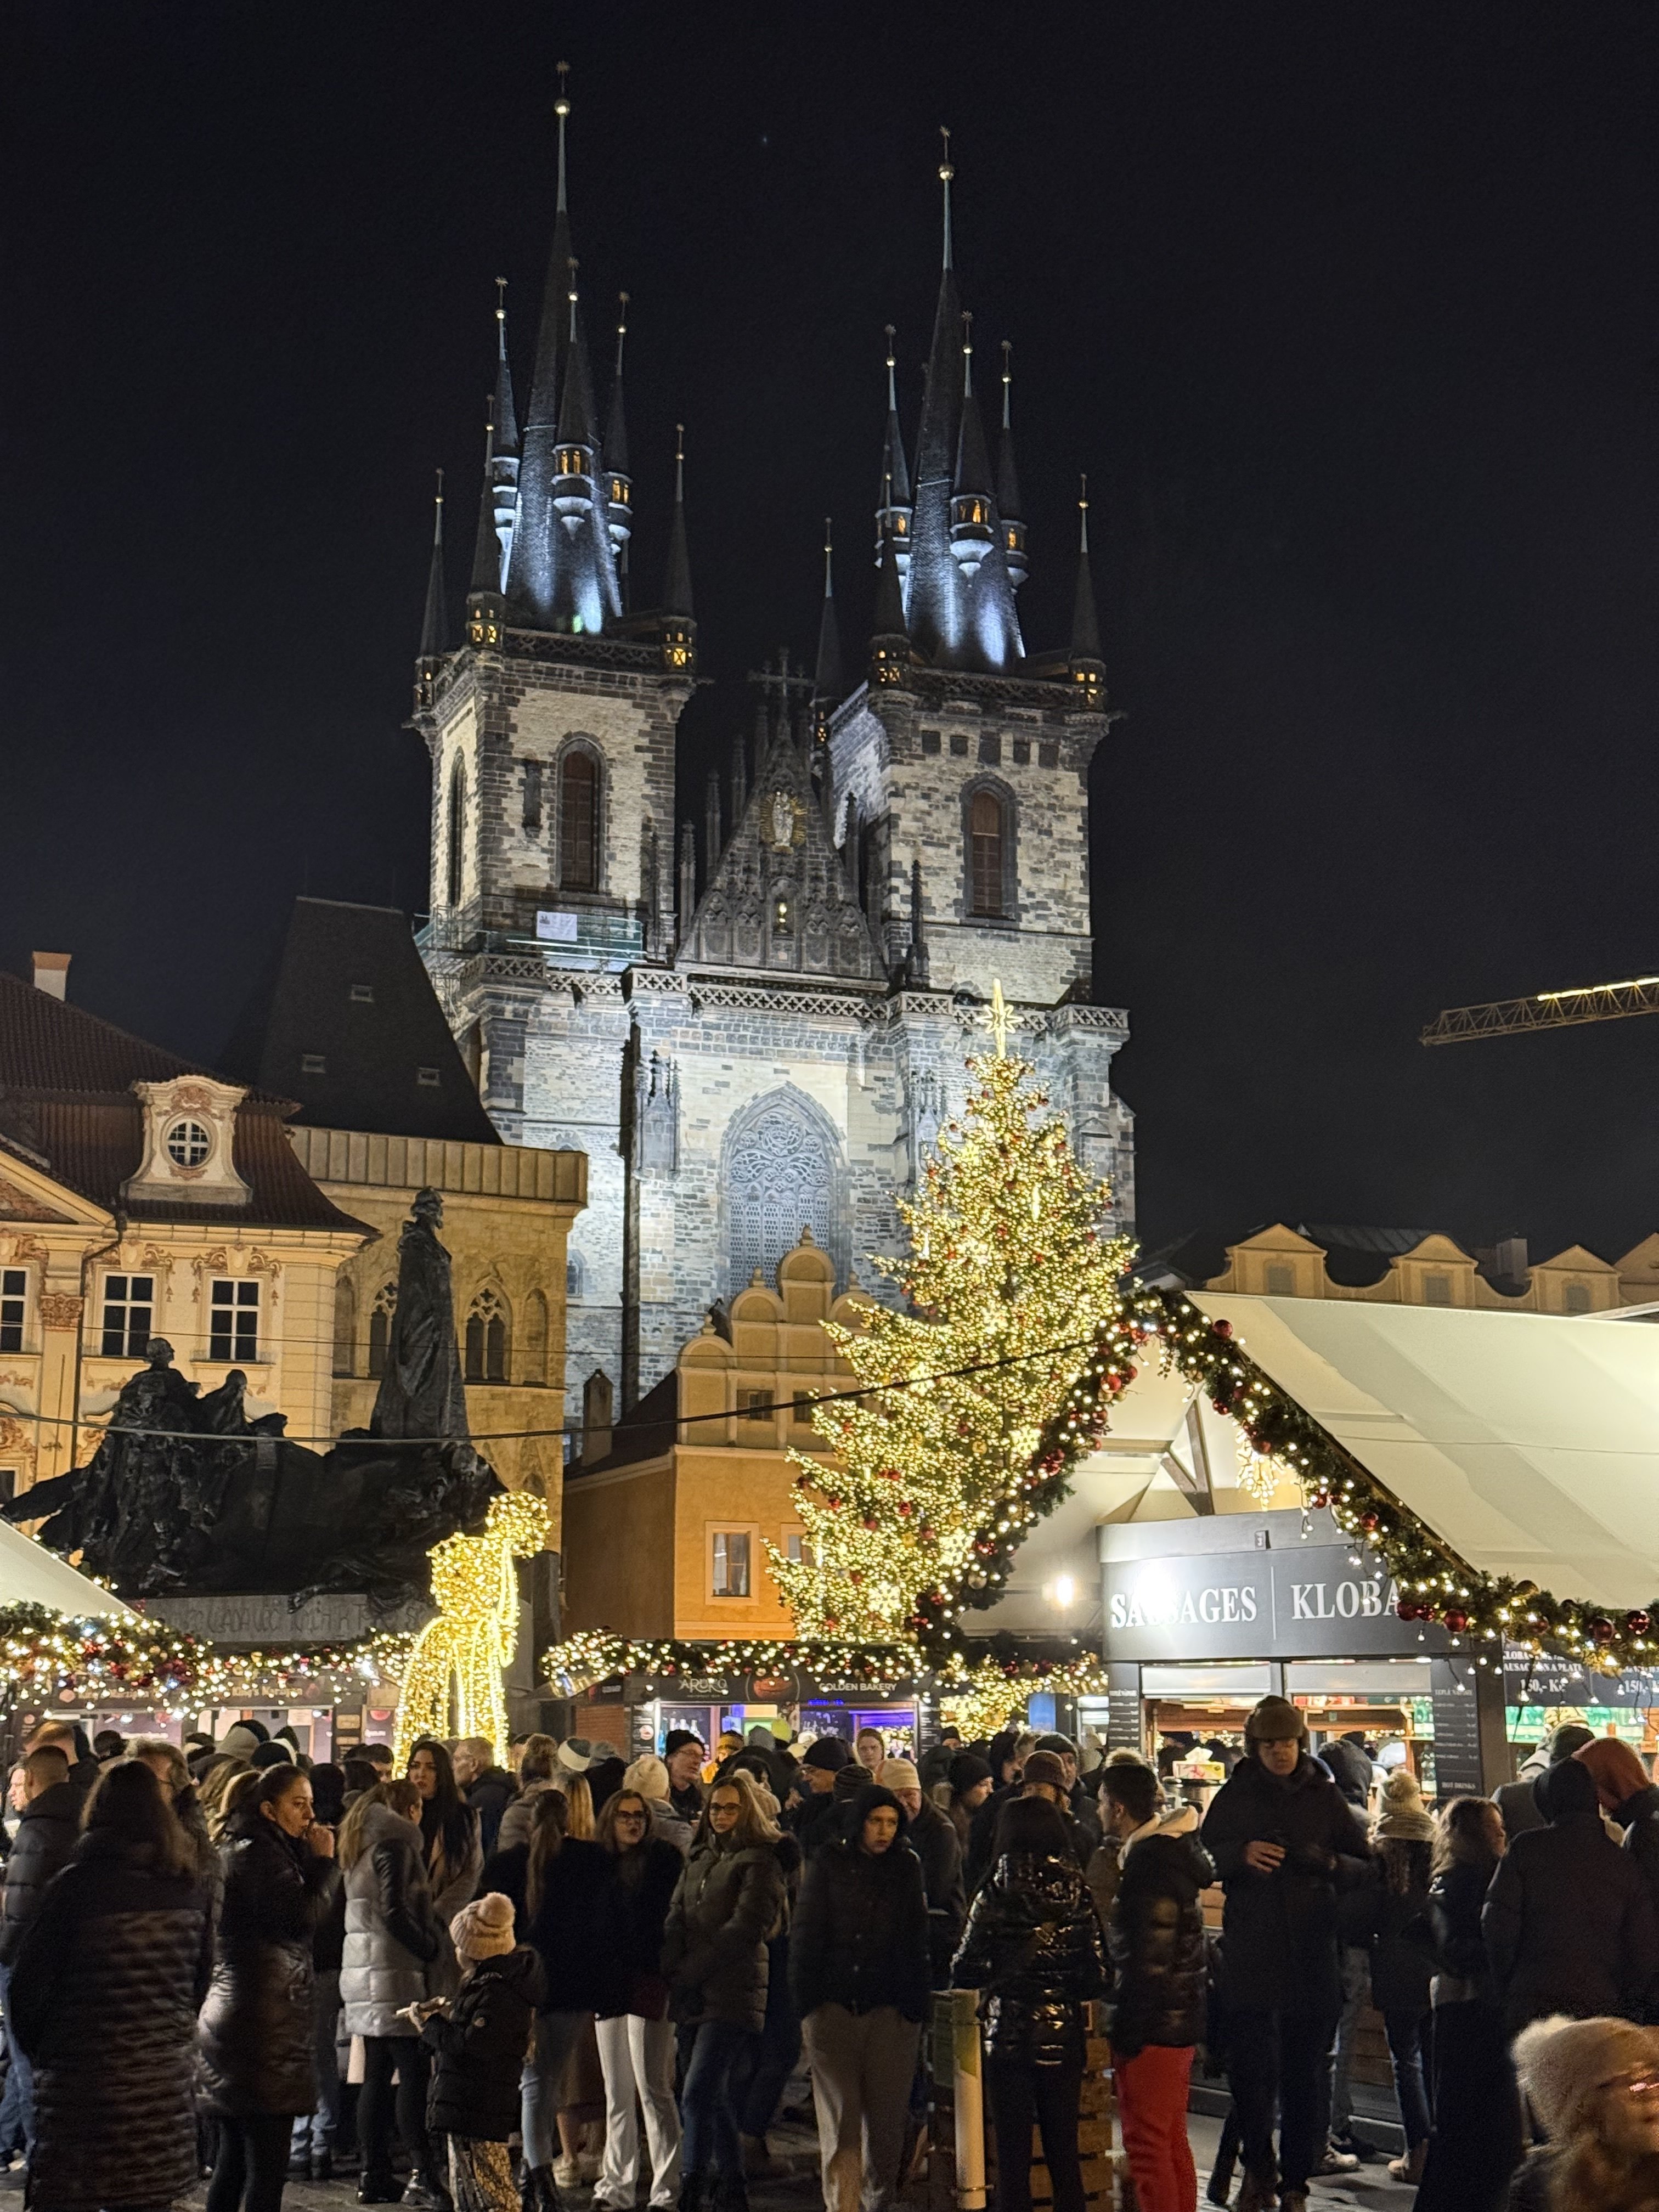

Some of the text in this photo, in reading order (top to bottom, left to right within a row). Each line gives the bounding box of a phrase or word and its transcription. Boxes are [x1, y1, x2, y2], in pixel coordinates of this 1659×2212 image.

[1110, 1585, 1257, 1629] SAAGES
[819, 1683, 897, 1692] GOLDEN BAKERY
